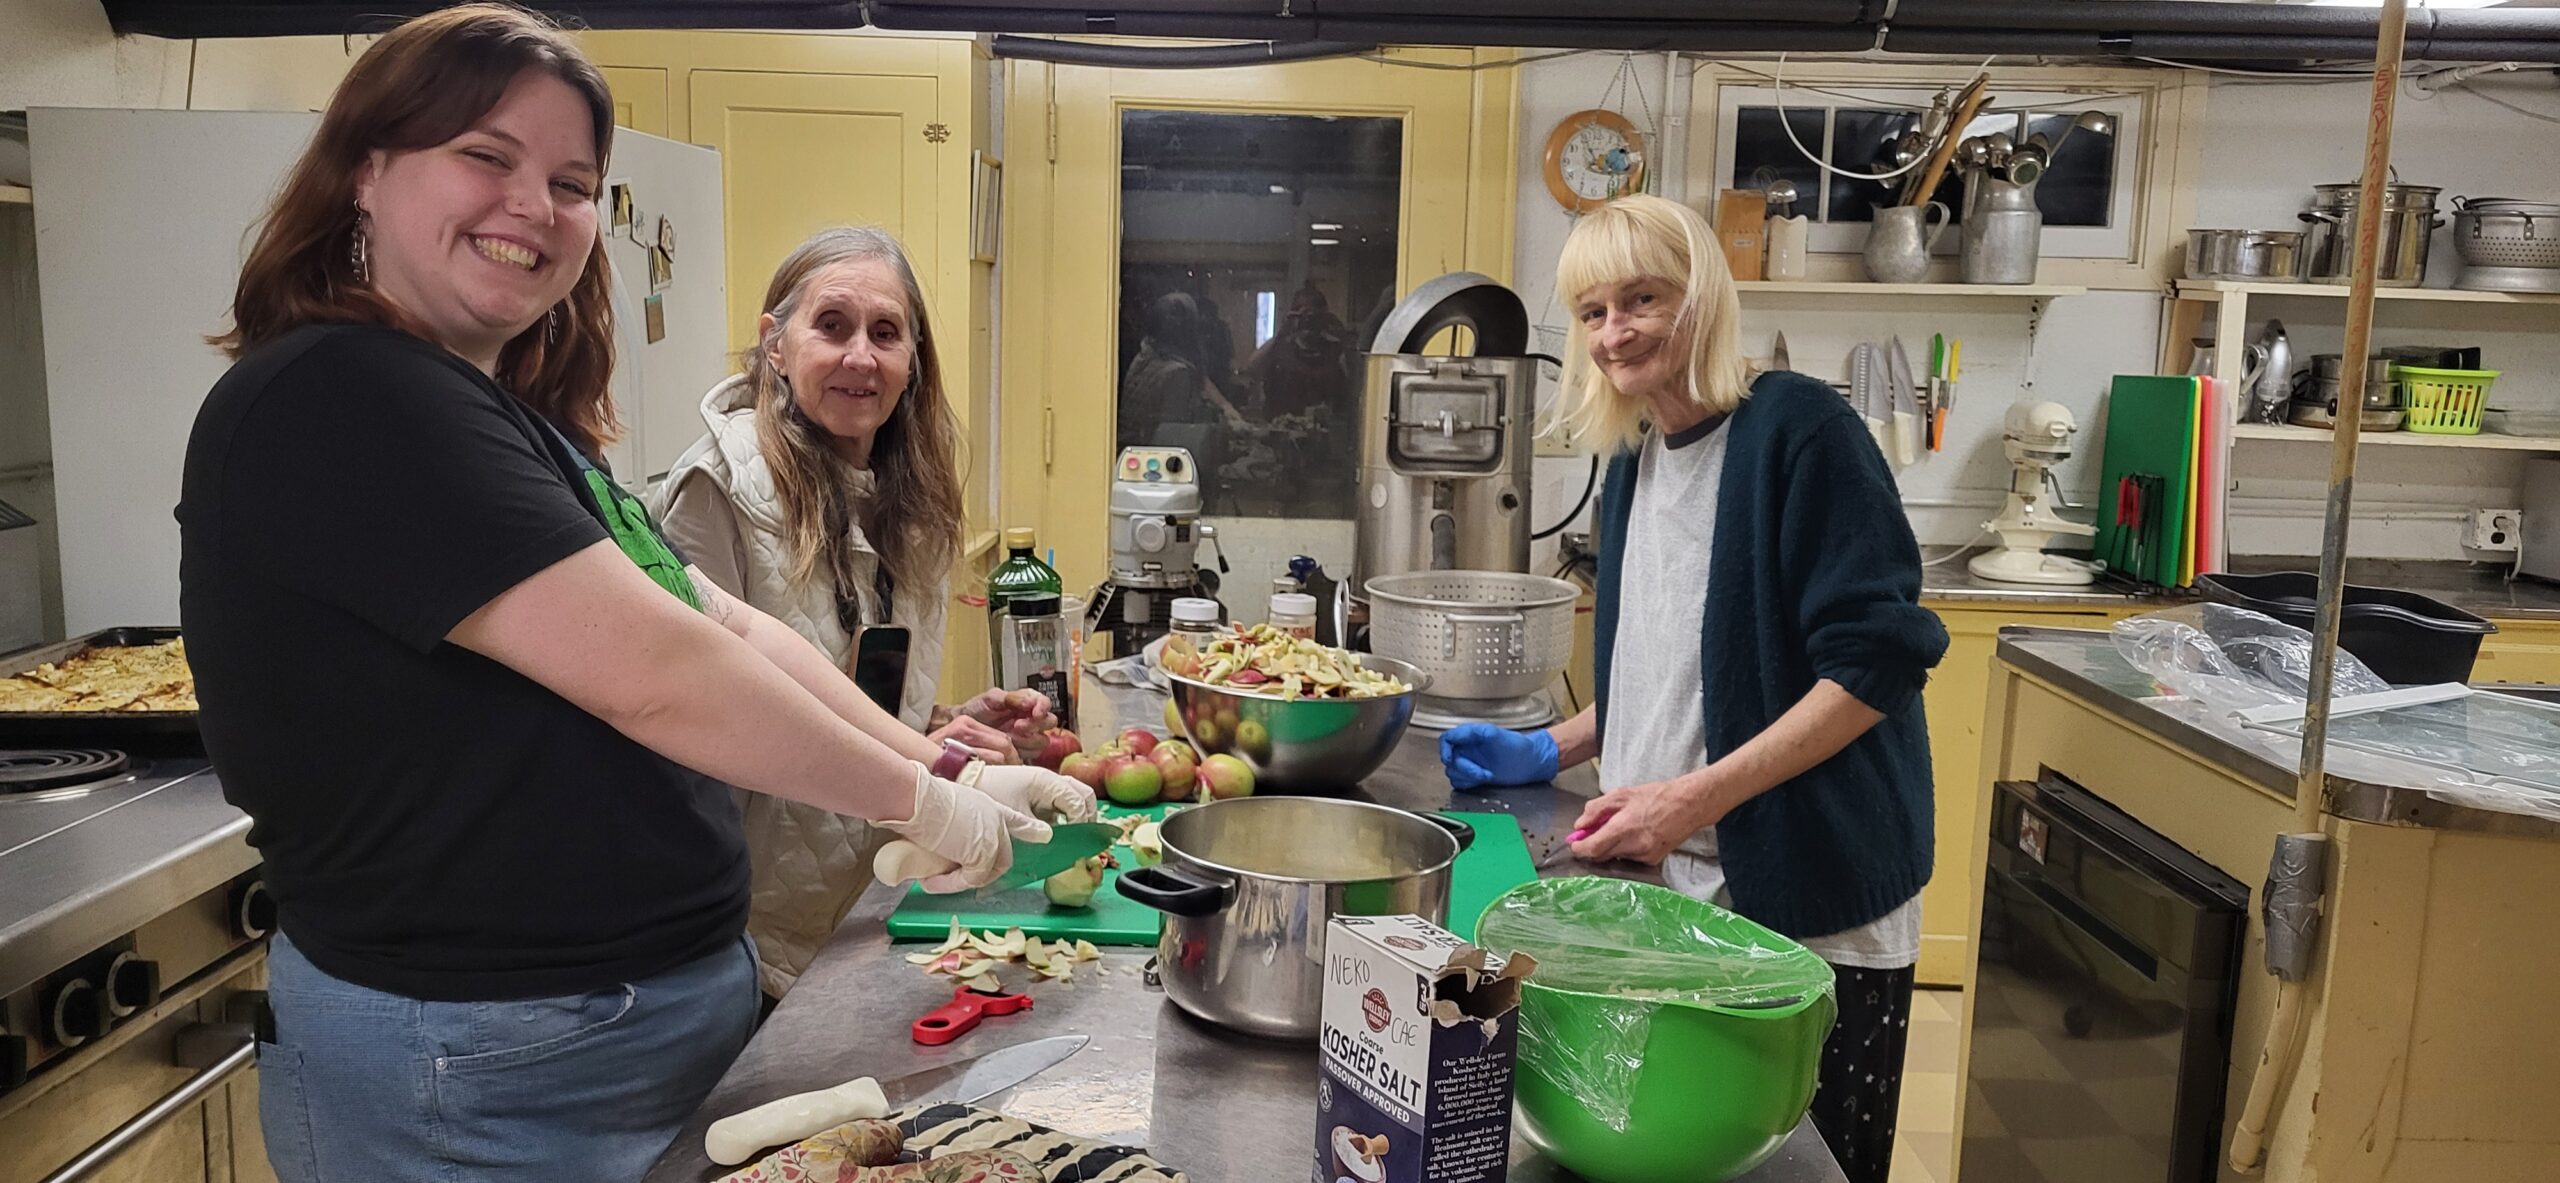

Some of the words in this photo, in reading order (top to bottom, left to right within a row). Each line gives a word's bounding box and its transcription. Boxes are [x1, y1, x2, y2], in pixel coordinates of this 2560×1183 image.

[1330, 953, 1370, 986] NEKO
[1420, 983, 1427, 1001] 3
[1364, 998, 1391, 1023] WELLSLEY
[1359, 1030, 1384, 1055] Coarse
[1323, 1021, 1376, 1080] KOSHER
[1379, 1061, 1421, 1107] SALT
[1452, 1066, 1477, 1075] Kosher
[1434, 1074, 1467, 1087] produced
[1437, 1084, 1458, 1094] island
[1325, 1056, 1362, 1093] PASSOVER
[1363, 1086, 1410, 1123] APPROVED
[1443, 1091, 1468, 1102] formed
[1464, 1127, 1484, 1137] mined
[1429, 1151, 1449, 1161] called
[1462, 1143, 1495, 1155] cathedrals
[1442, 1159, 1464, 1168] known
[1477, 1151, 1504, 1161] centuries
[1451, 1166, 1477, 1175] volcanic
